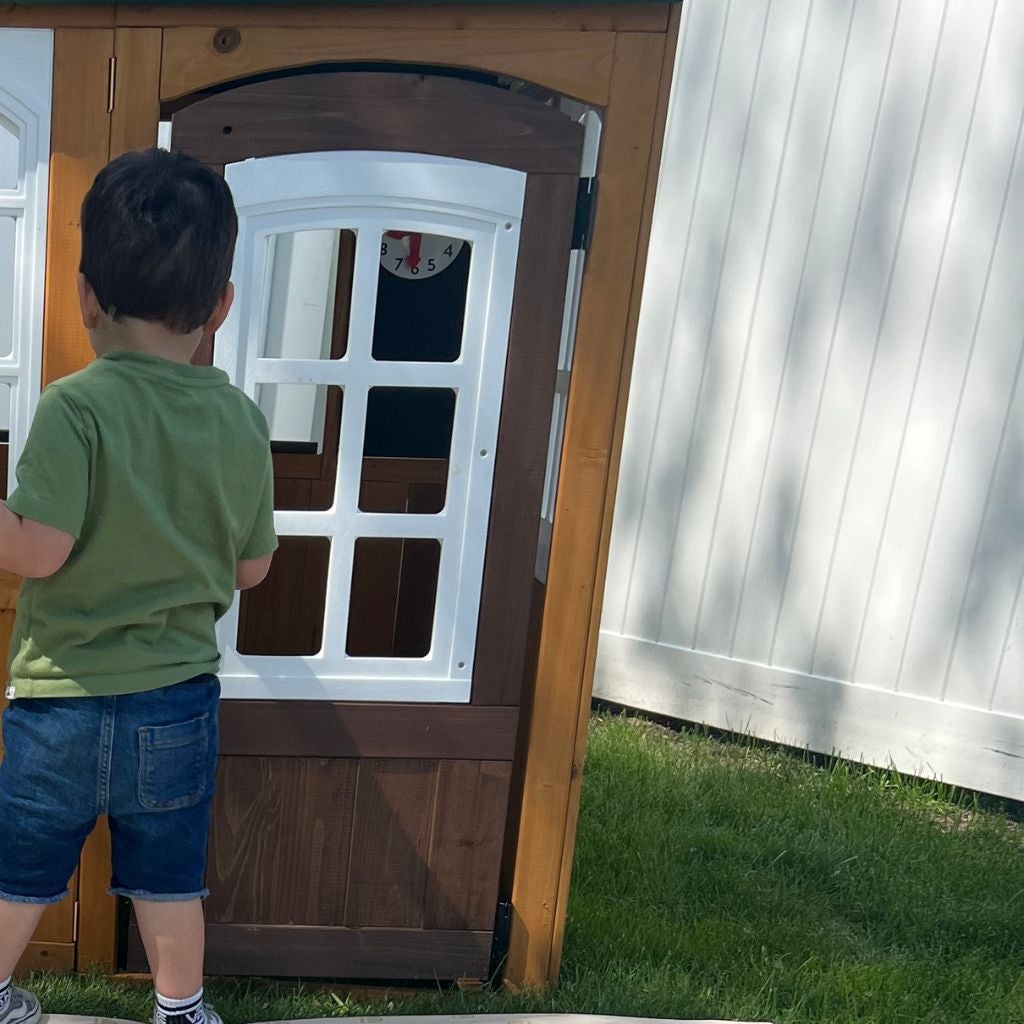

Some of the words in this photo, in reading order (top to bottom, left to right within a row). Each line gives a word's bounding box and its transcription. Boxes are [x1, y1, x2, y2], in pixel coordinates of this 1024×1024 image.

[381, 243, 387, 255] 8
[444, 244, 453, 257] 4
[395, 258, 403, 270] 7
[428, 259, 435, 271] 5
